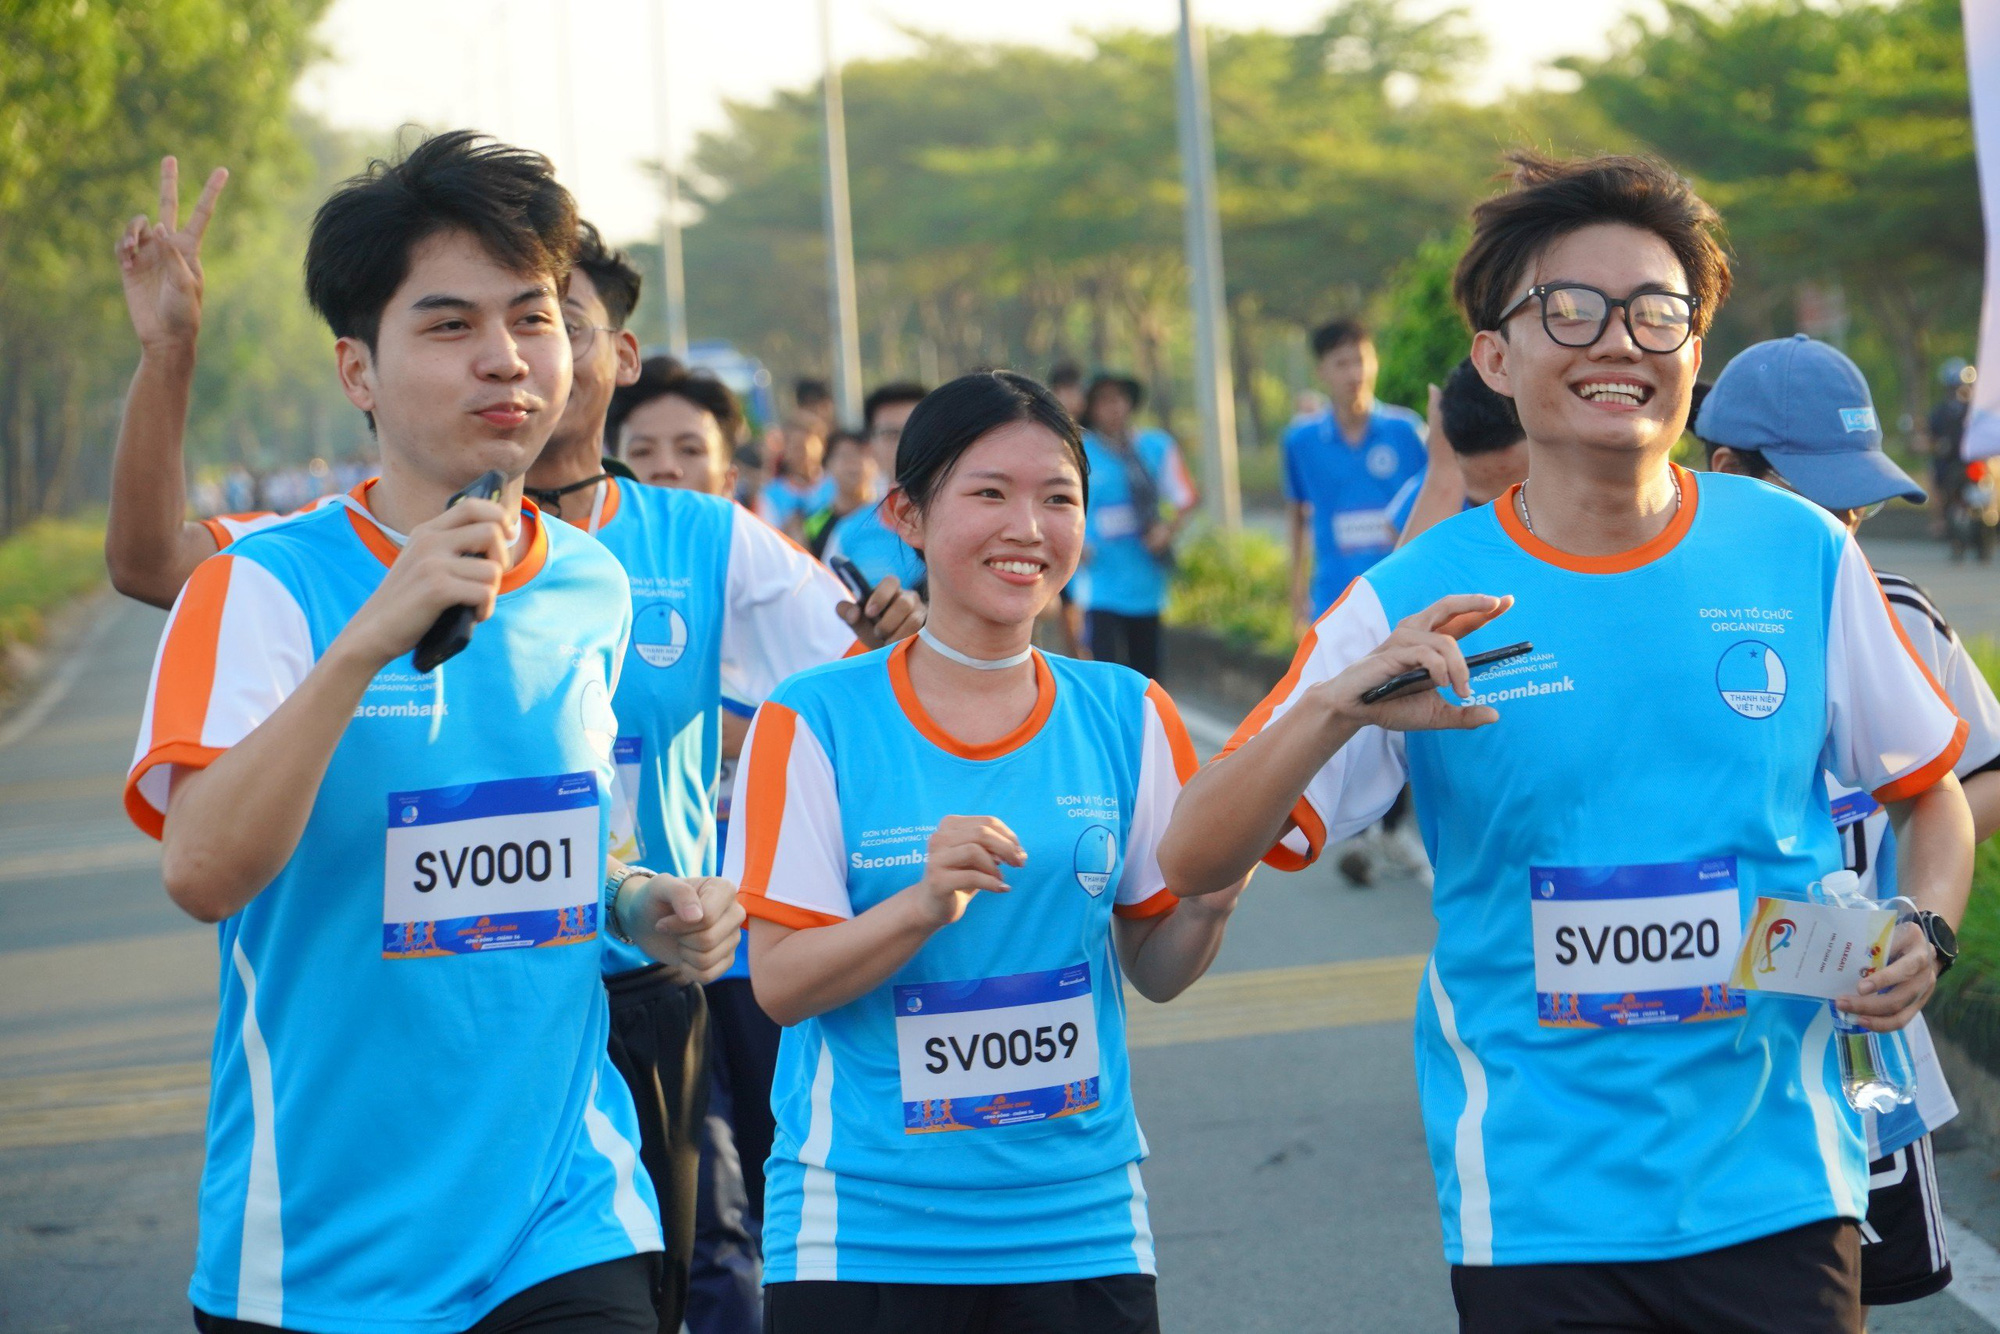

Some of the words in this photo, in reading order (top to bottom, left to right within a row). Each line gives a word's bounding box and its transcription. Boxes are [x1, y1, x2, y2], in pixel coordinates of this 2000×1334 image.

[1699, 608, 1728, 618] ĐƠN
[1730, 608, 1742, 619] VỊ
[1743, 606, 1760, 619] TỔ
[1762, 608, 1793, 620] CHỨC
[1711, 622, 1786, 634] ORGANIZERS
[1472, 664, 1538, 683] ACCOMPANYING
[1539, 661, 1559, 670] UNIT
[1730, 694, 1758, 702] THANH
[353, 700, 449, 718] acombank
[1756, 704, 1773, 713] NAM
[1056, 795, 1082, 805] ĐƠN
[1103, 797, 1119, 807] CH
[862, 830, 880, 838] ĐƠN
[881, 829, 889, 837] VỊ
[890, 826, 914, 836] ĐỒNG
[860, 834, 922, 847] ACCOMPANYING
[413, 837, 572, 893] SV0001
[851, 848, 930, 869] Sacomba
[1555, 918, 1720, 966] SV0020
[1837, 941, 1852, 972] DELEGATE
[925, 1022, 1079, 1074] SV0059
